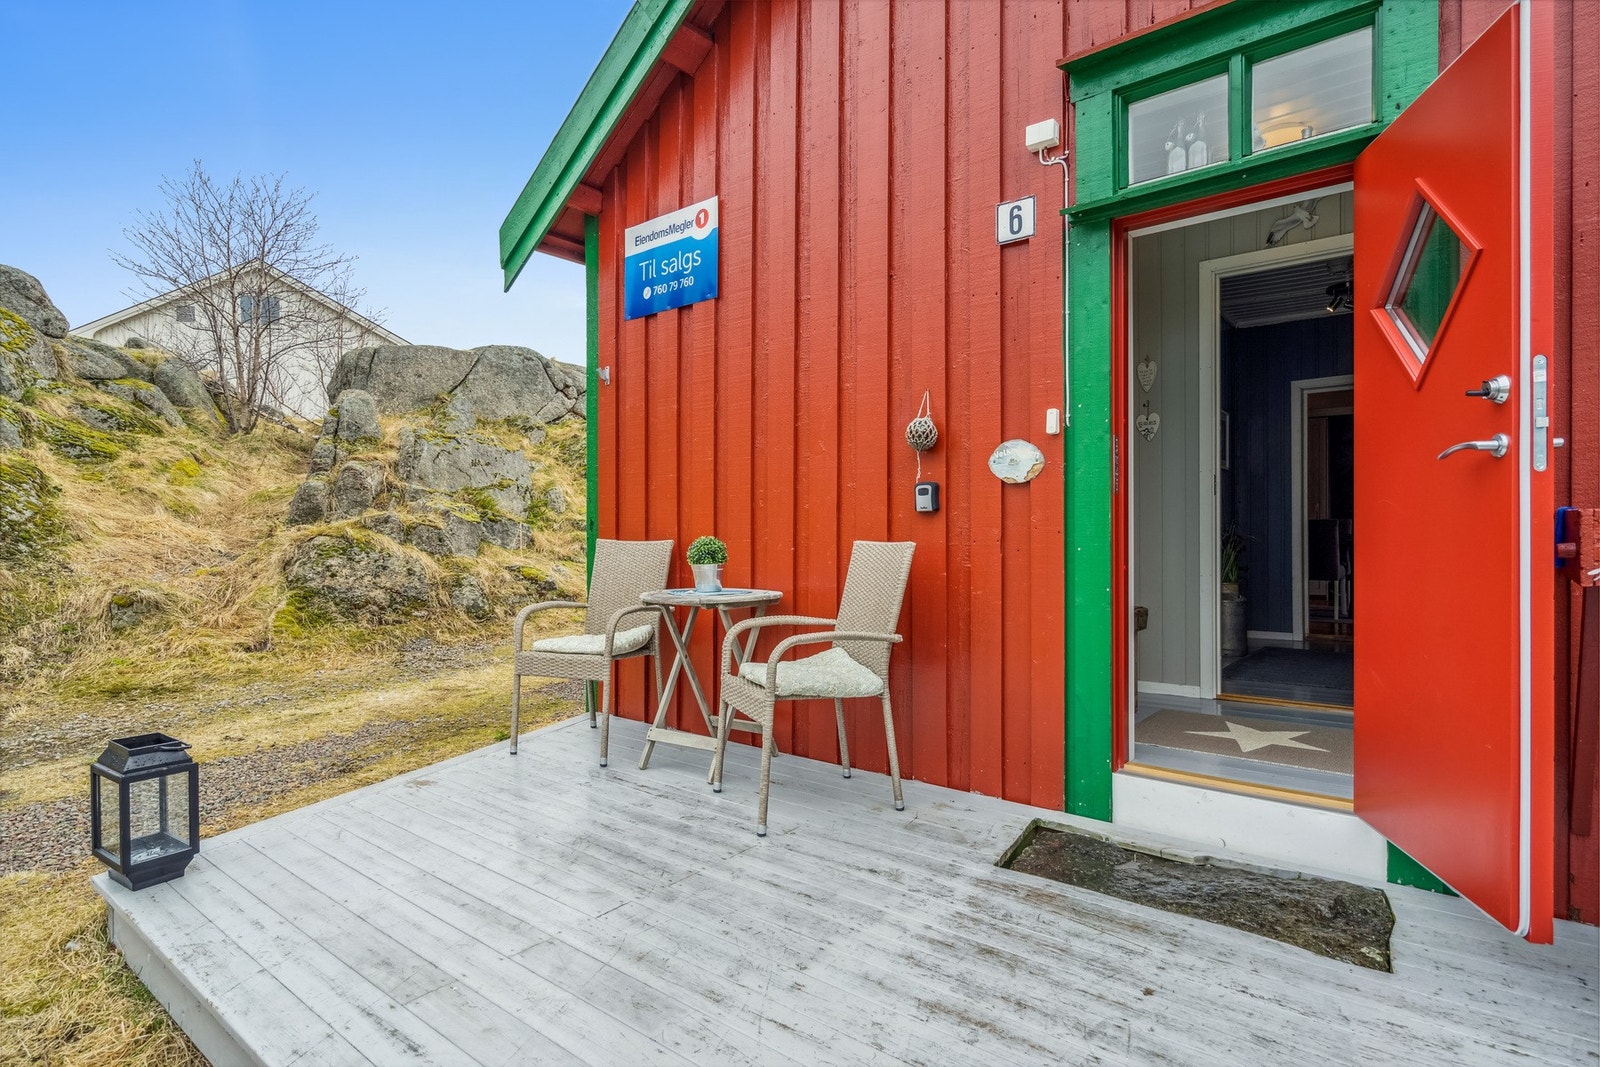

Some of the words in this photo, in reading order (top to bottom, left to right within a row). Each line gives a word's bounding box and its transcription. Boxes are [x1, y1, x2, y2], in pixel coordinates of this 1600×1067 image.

[635, 219, 694, 247] EiendomsMegler
[1010, 205, 1022, 235] 6
[639, 258, 656, 282] Til
[661, 250, 701, 275] salgs
[653, 283, 668, 296] 760
[669, 281, 678, 292] 79
[679, 276, 694, 288] 760
